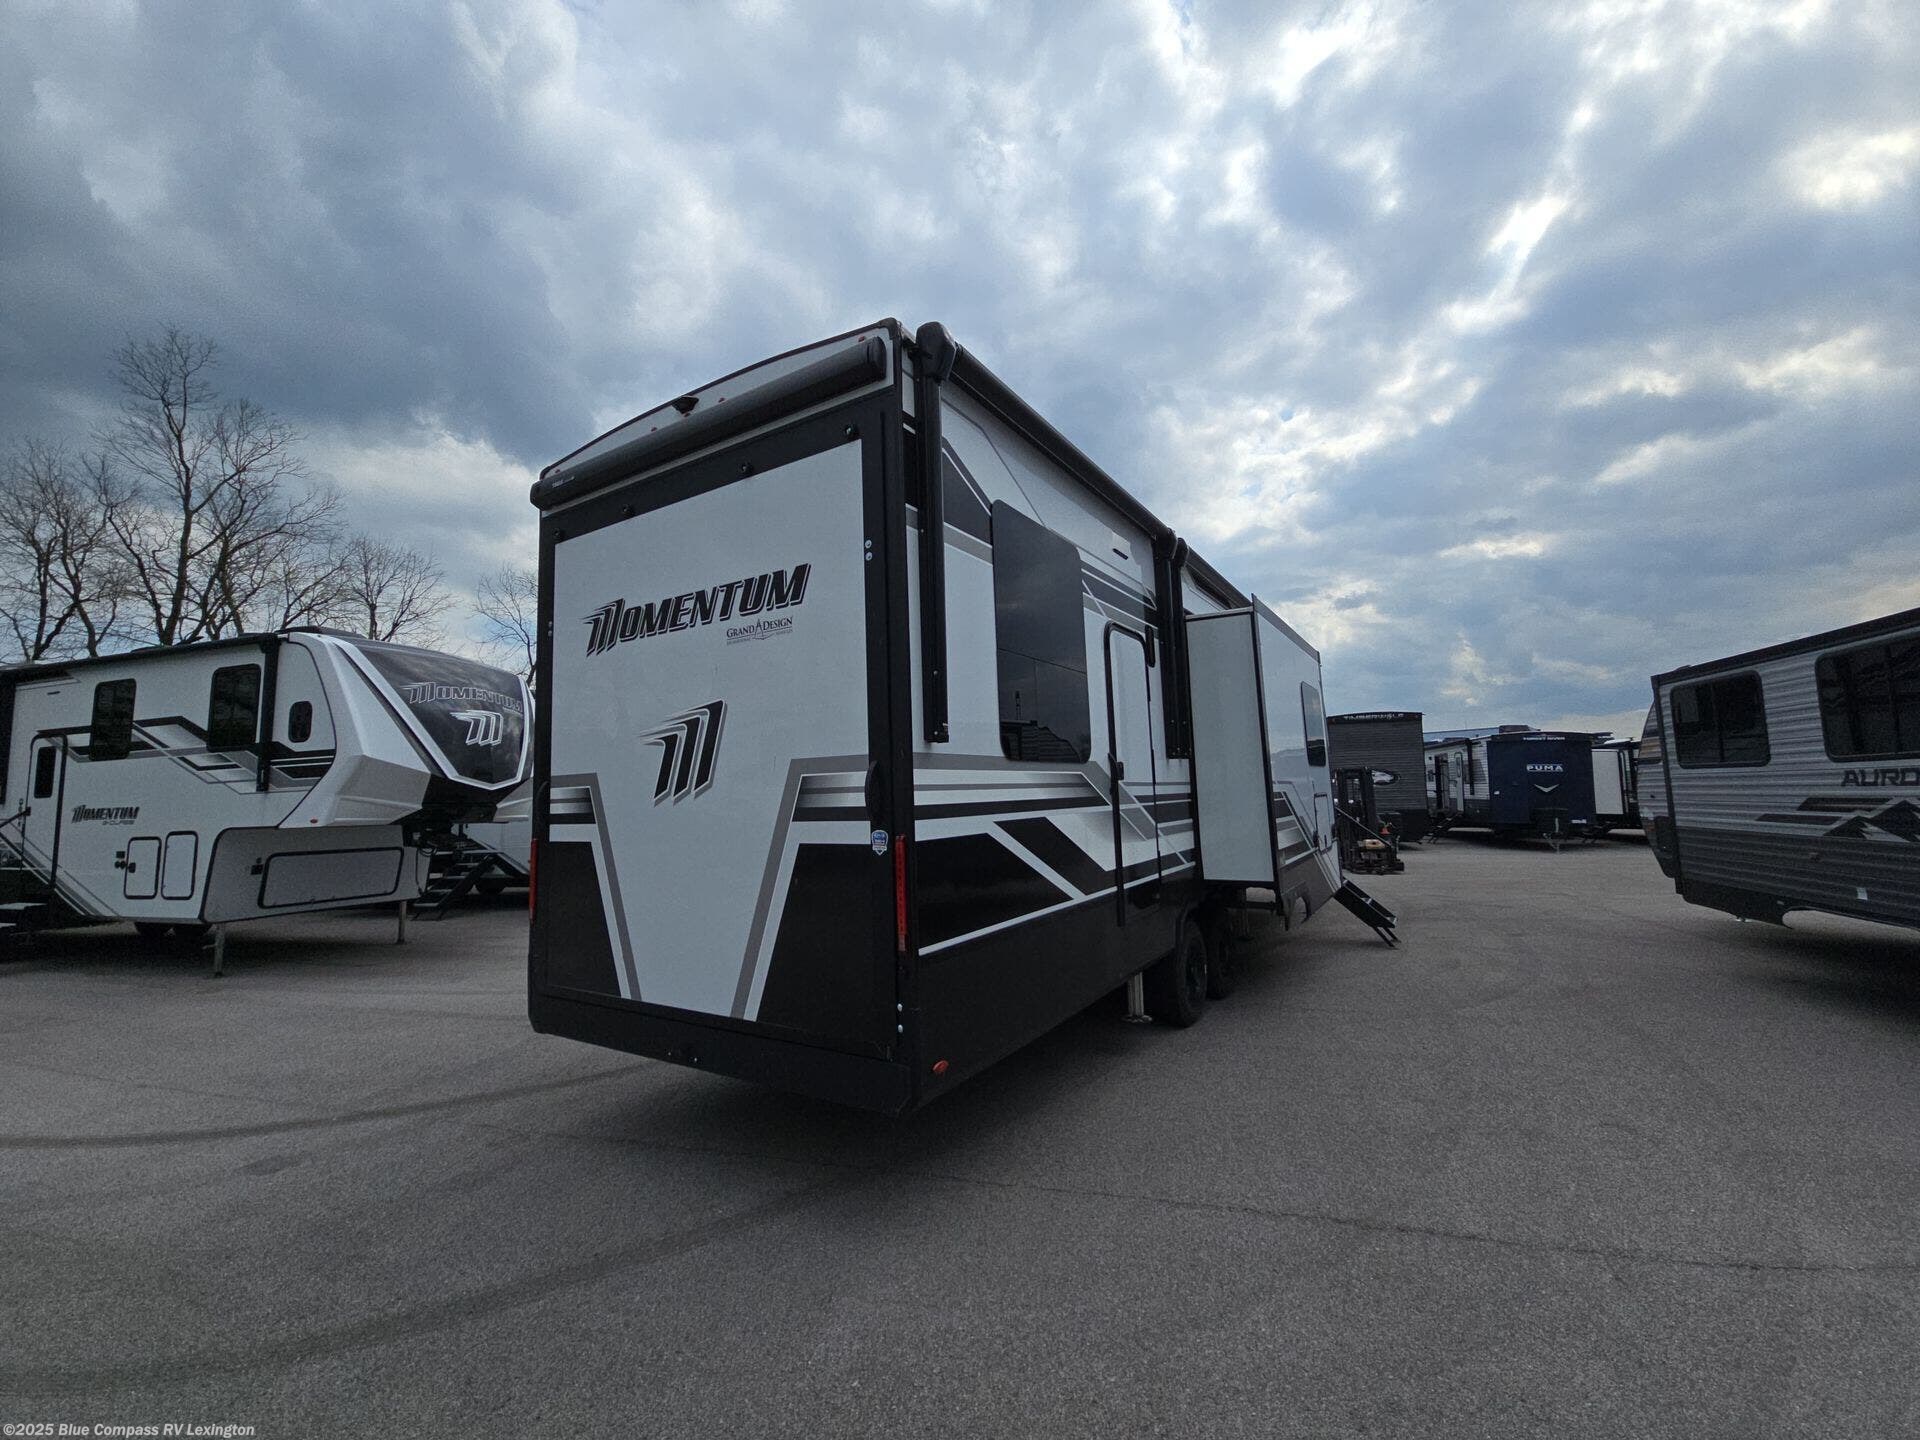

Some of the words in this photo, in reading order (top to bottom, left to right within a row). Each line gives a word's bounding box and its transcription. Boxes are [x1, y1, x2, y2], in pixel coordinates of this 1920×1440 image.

[581, 563, 811, 657] MOMENTUM
[726, 625, 755, 638] GRAND
[763, 616, 793, 631] DESIGN
[1526, 763, 1564, 772] PUMA
[1841, 767, 1920, 787] AURO
[71, 804, 140, 824] MOMENTUM
